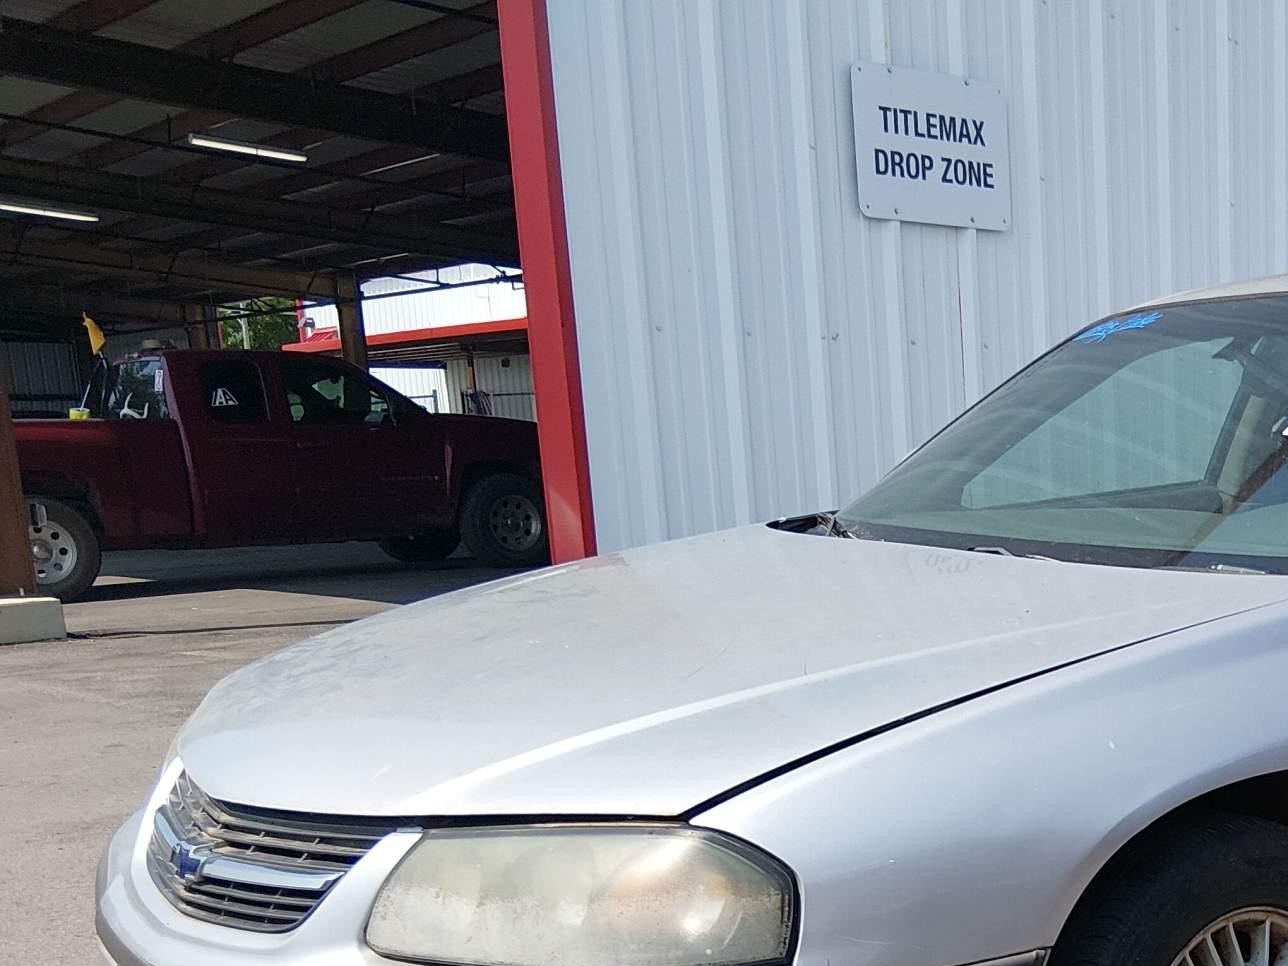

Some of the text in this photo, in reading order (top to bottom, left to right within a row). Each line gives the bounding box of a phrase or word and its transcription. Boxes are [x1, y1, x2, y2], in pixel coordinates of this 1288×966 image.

[878, 105, 986, 147] TITLEMAX
[874, 148, 995, 189] DROP ZONE
